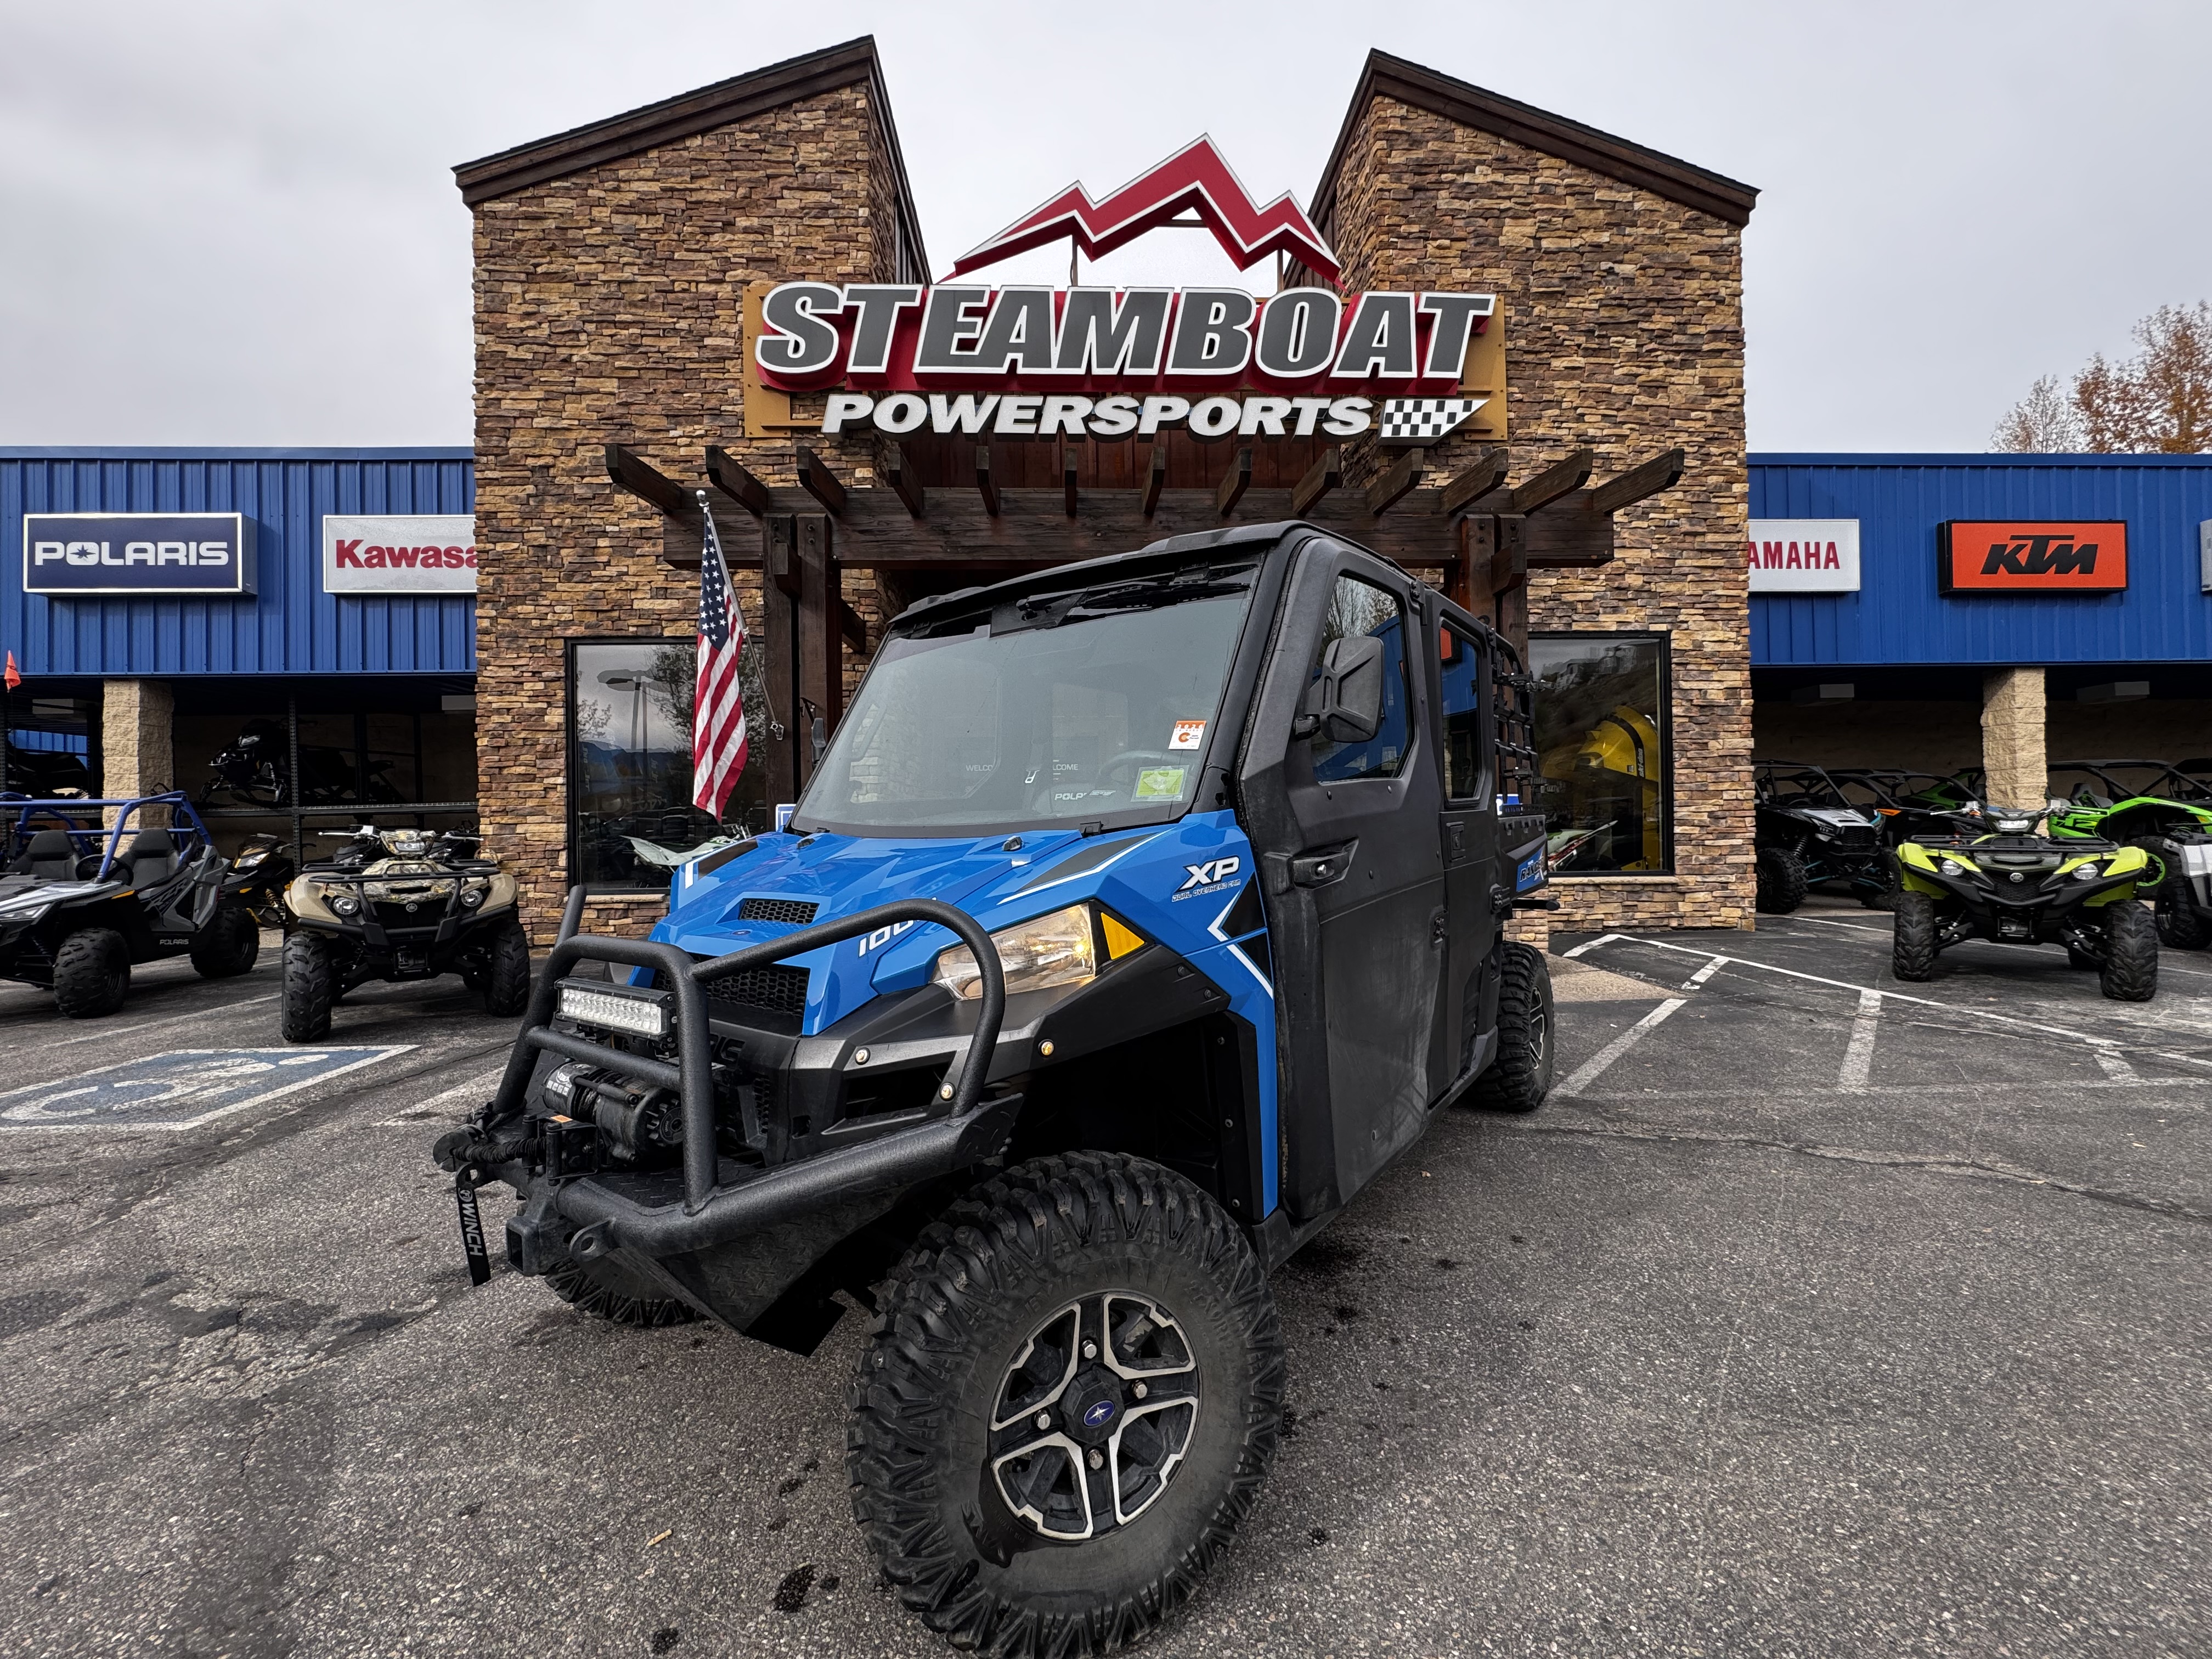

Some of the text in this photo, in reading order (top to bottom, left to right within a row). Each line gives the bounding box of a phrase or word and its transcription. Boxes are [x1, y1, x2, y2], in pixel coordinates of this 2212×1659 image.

[754, 281, 1496, 379] STEAMBOAT
[821, 392, 1373, 437] POWERSPORTS
[35, 542, 228, 566] POLARIS
[1748, 541, 1841, 569] AMAHA
[1980, 535, 2098, 574] KTM
[1177, 856, 1240, 891] XP
[1172, 891, 1192, 902] DUAL
[1193, 883, 1227, 897] OVERHEAD
[462, 1203, 483, 1256] WINCH
